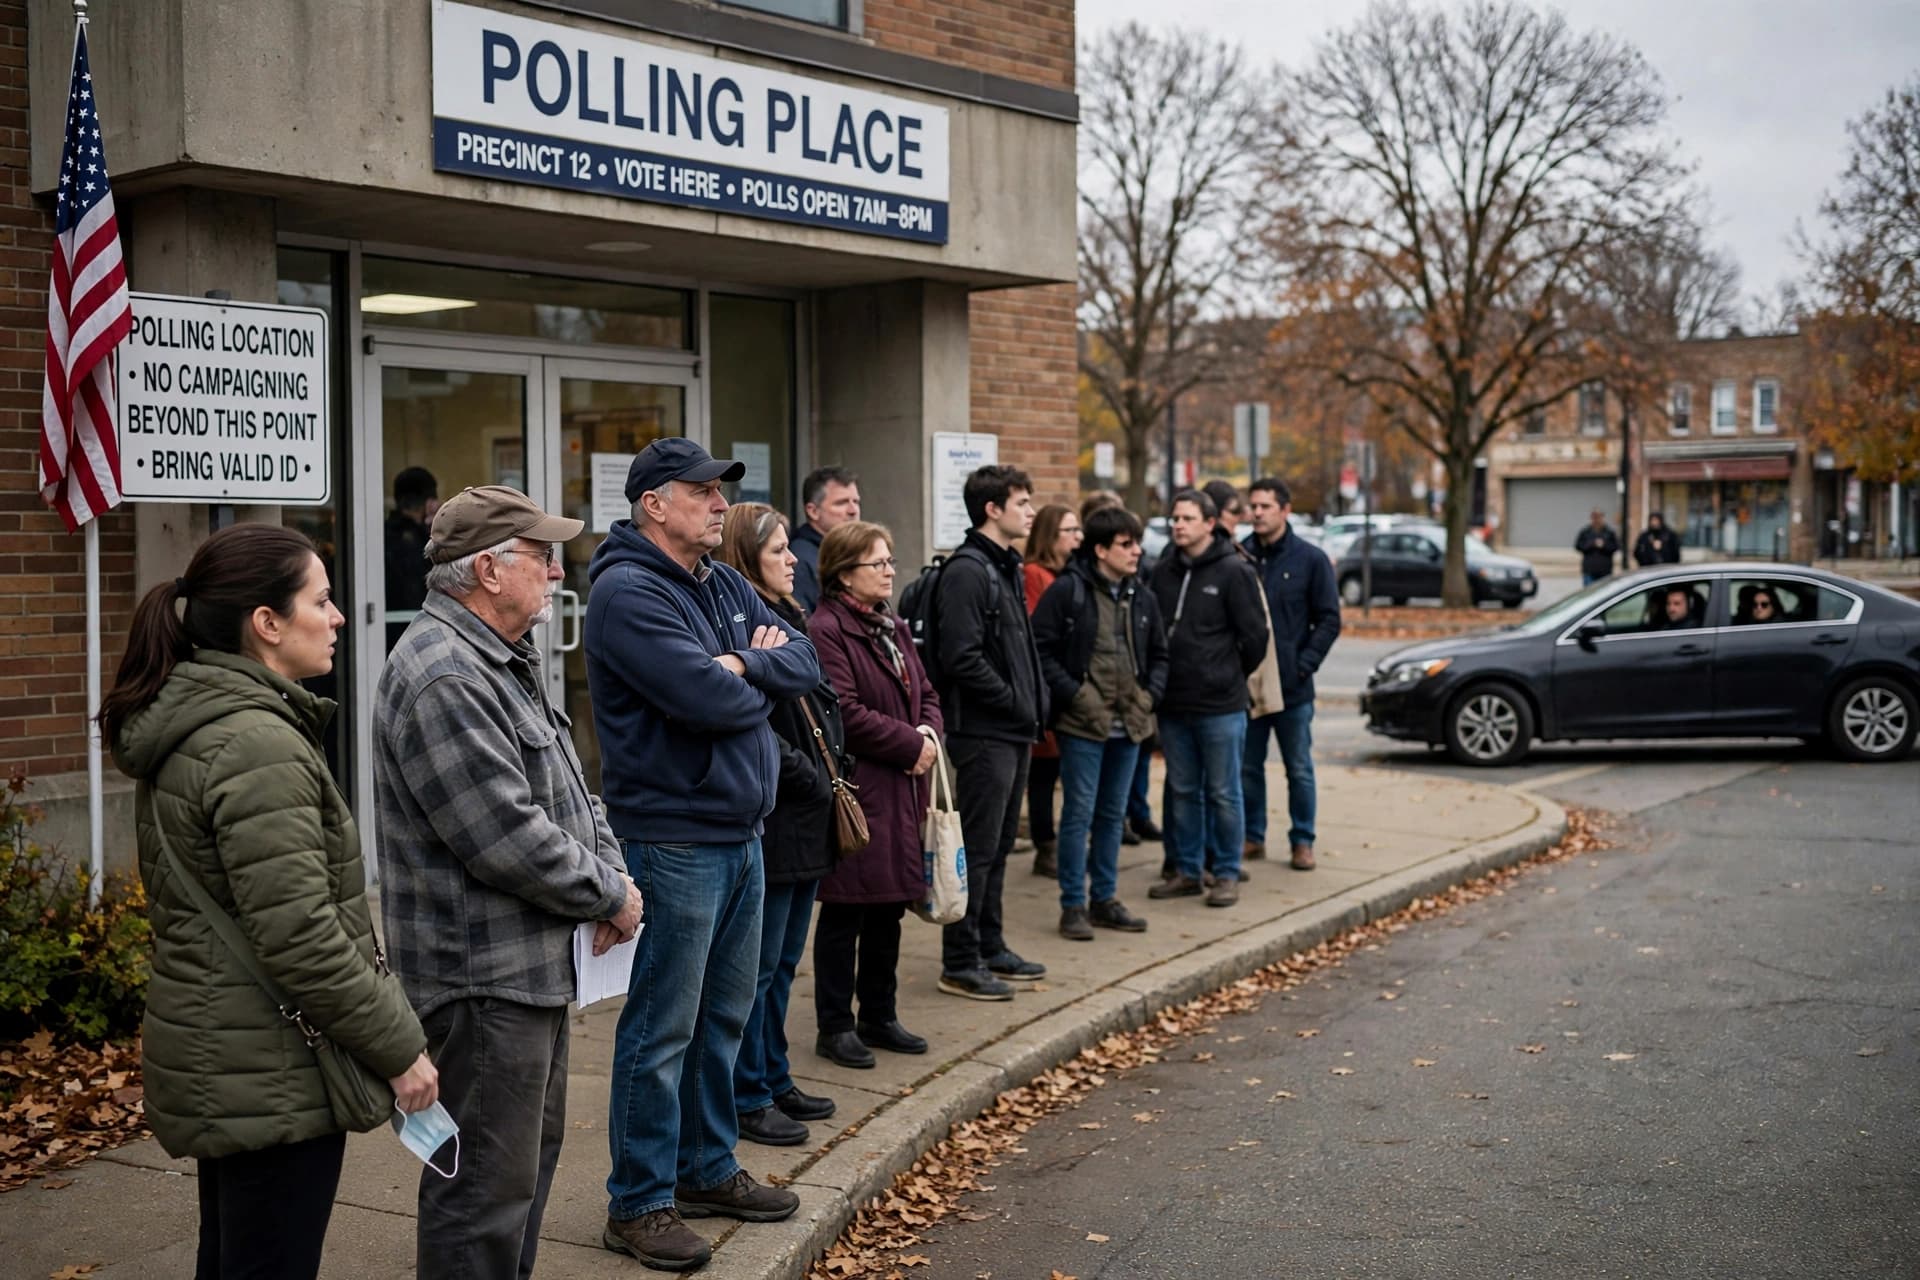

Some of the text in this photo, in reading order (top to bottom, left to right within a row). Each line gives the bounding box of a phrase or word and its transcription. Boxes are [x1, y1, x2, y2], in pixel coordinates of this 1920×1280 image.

[482, 28, 923, 180] POLLING PLACE
[457, 131, 564, 175] PRECINCT
[569, 151, 592, 180] 12
[613, 157, 666, 192] VOTE
[670, 166, 721, 200] HERE
[742, 177, 799, 212] POLLS
[802, 188, 850, 220] OPEN
[129, 315, 314, 358] POLLING LOCATION
[143, 361, 308, 401] NO CAMPAIGNING
[128, 403, 318, 441] BEYOND THIS POINT
[152, 449, 298, 483] BRING VALID ID
